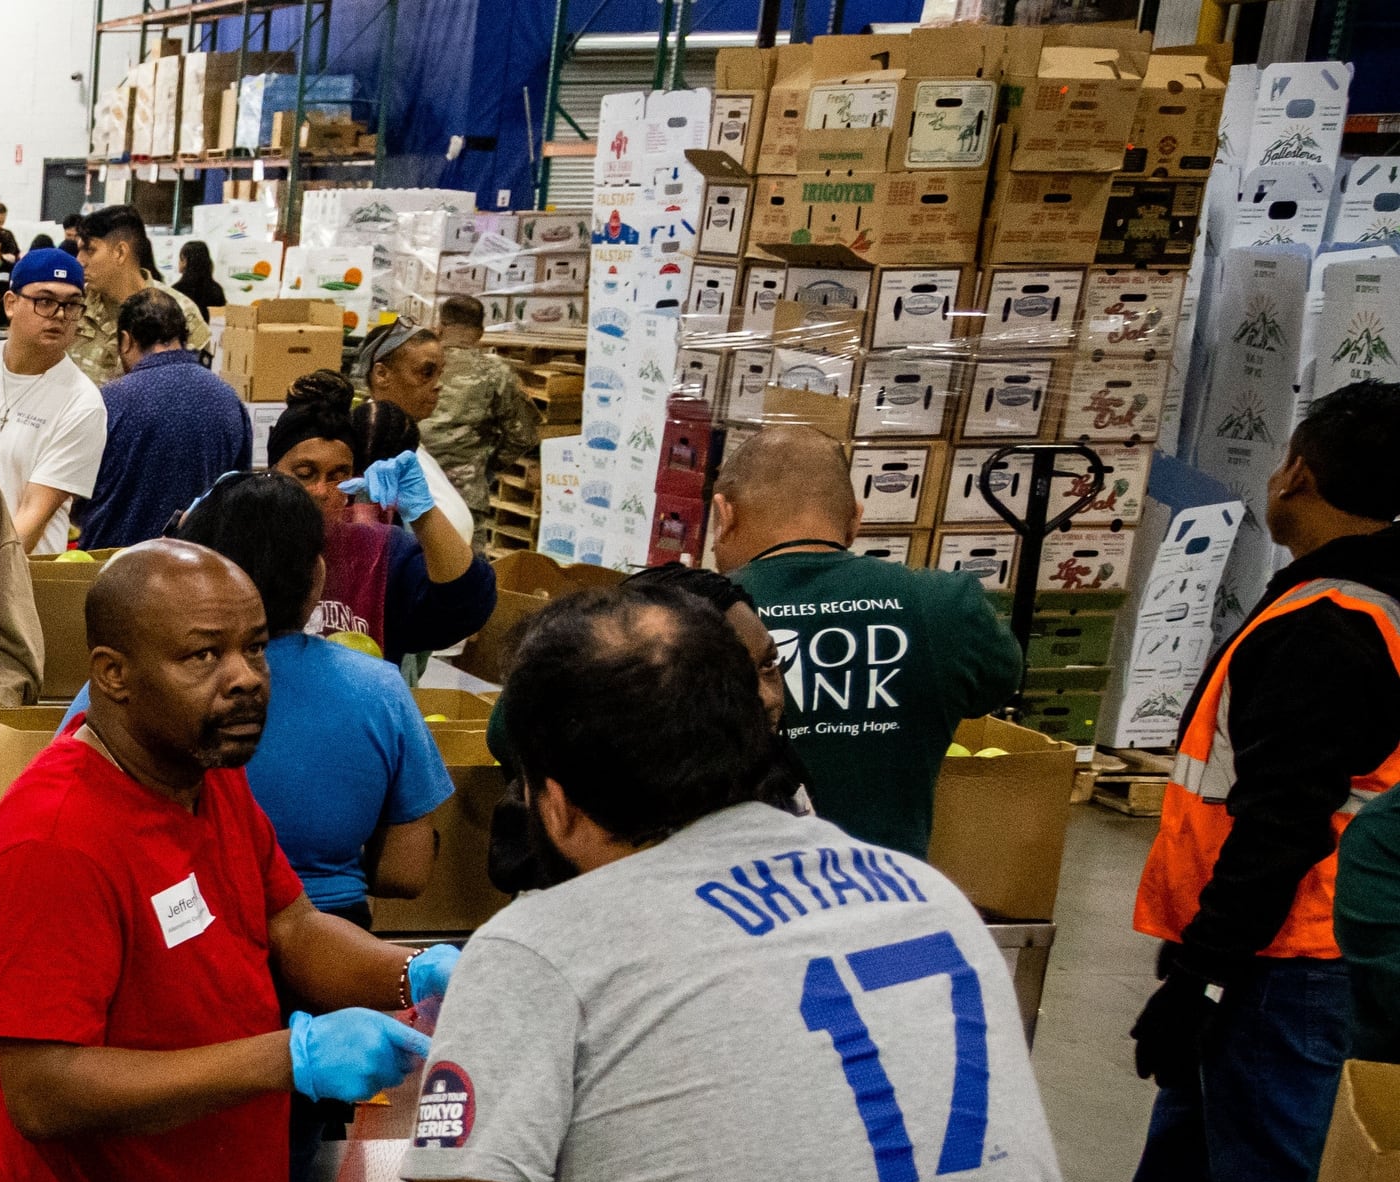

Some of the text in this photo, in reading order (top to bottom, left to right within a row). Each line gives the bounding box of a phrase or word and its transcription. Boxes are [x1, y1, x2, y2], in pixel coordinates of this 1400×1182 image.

[826, 91, 855, 104] Fresh
[596, 192, 636, 207] FALSTAFF
[802, 181, 877, 204] IRIGOYEN
[594, 250, 633, 264] FALSTAFF
[545, 472, 580, 488] FALSTA
[757, 598, 904, 618] NGELES REGIONAL
[808, 624, 909, 668] OD
[812, 668, 901, 712] NK
[815, 721, 860, 737] Giving
[862, 720, 901, 734] Hope.
[694, 847, 928, 937] OHTANI
[448, 1091, 468, 1102] TOUR
[420, 1103, 464, 1121] TOKYO
[416, 1119, 464, 1138] SERIES
